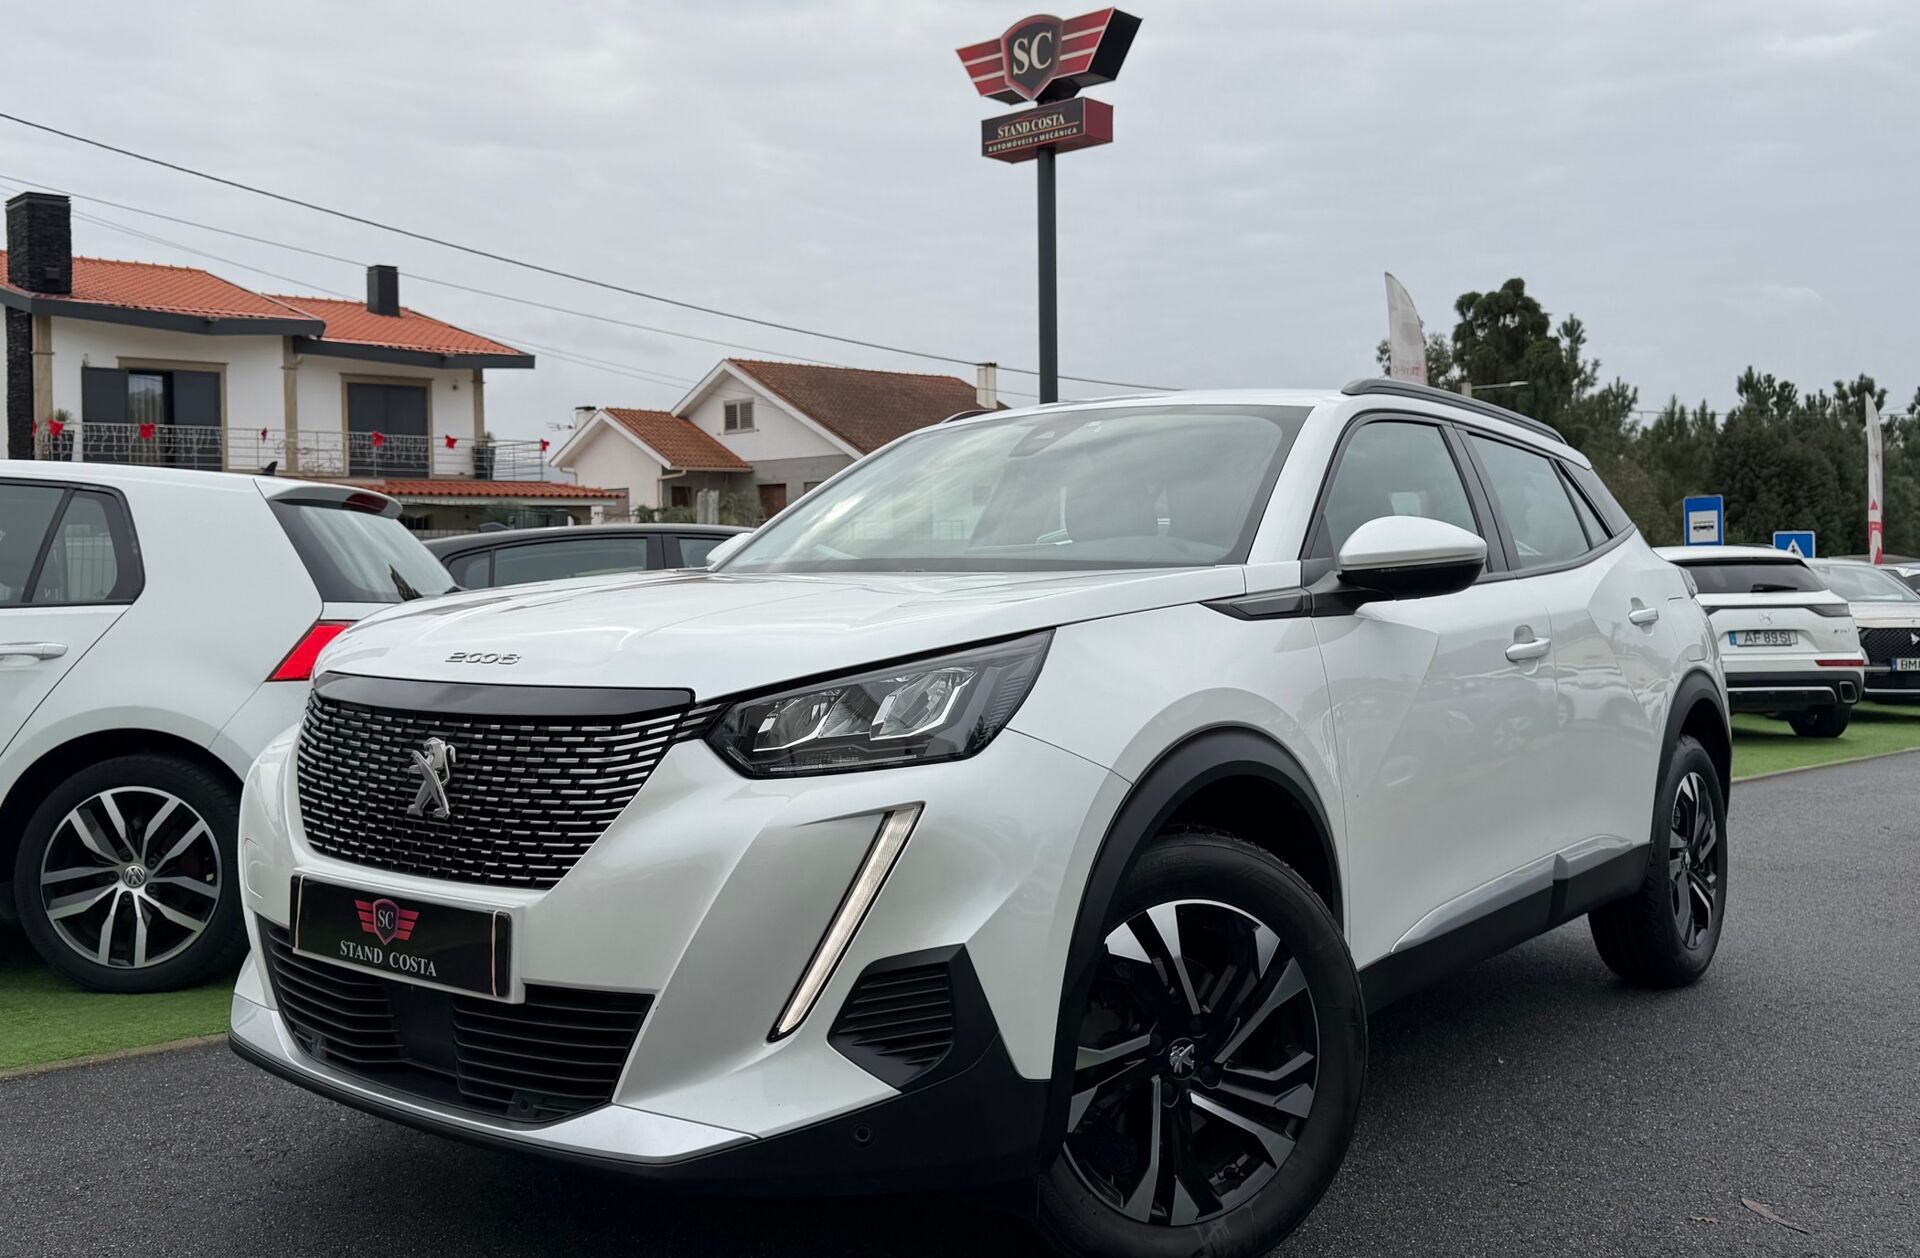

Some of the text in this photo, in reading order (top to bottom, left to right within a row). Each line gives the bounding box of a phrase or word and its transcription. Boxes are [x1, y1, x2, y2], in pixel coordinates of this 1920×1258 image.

[1013, 31, 1052, 76] SC
[997, 114, 1065, 138] STAND COSTA
[1744, 631, 1761, 644] AF
[1763, 631, 1778, 644] 89
[445, 652, 521, 665] 2008
[377, 909, 394, 930] SC
[340, 940, 437, 977] STAND COSTA
